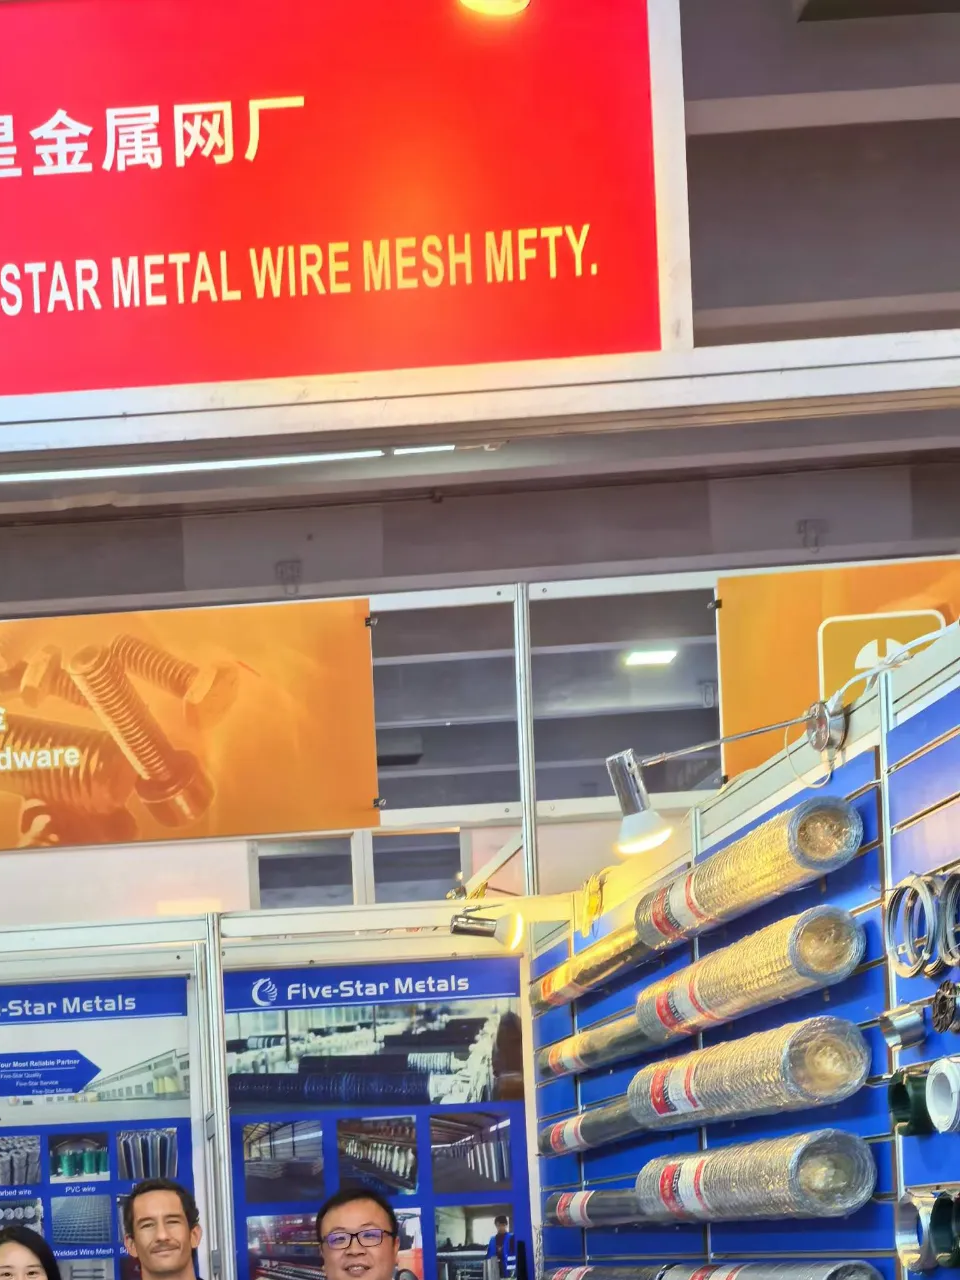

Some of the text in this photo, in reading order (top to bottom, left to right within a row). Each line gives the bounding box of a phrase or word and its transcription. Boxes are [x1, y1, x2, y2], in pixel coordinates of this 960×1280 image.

[112, 249, 241, 308] METAL
[249, 242, 351, 298] WIRE
[362, 232, 473, 291] MESH
[484, 224, 598, 283] MFTY.
[287, 975, 470, 1001] Five-Star Metals
[62, 994, 136, 1014] Metals
